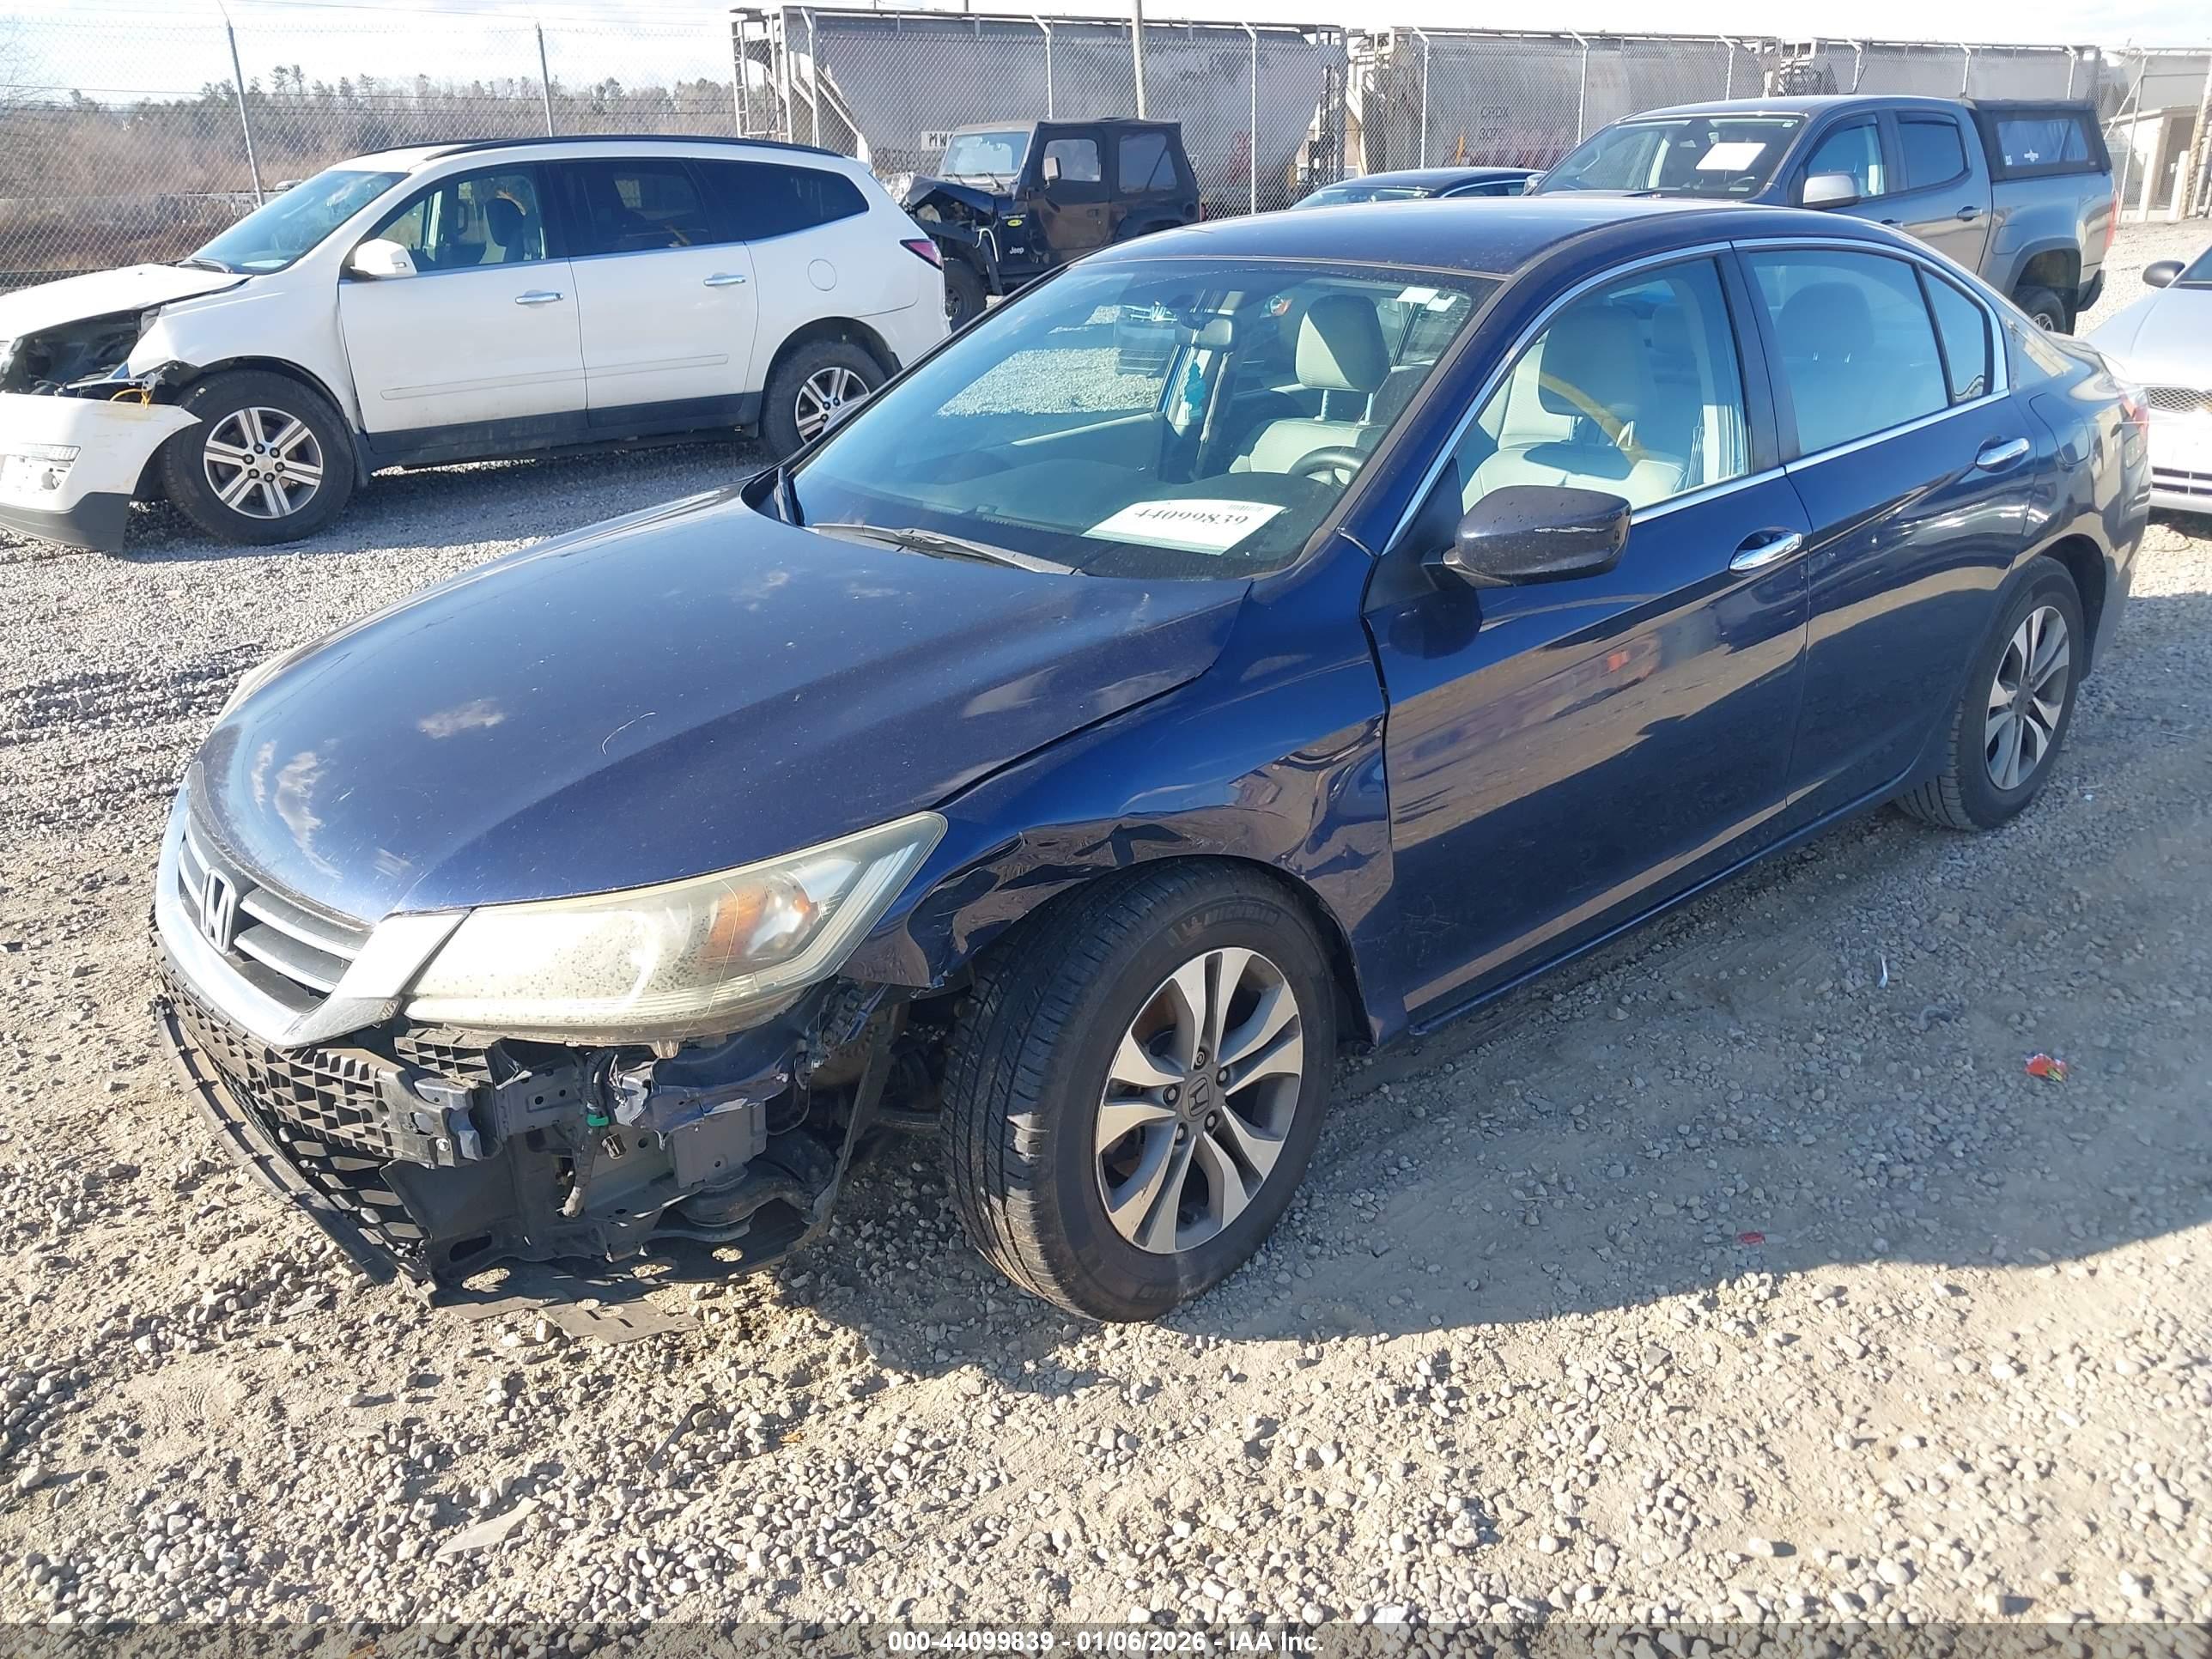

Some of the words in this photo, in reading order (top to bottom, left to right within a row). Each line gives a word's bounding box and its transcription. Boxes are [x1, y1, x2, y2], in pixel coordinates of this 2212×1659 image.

[929, 133, 953, 147] MW
[1009, 246, 1024, 255] Jeep
[1134, 508, 1249, 526] 44099839
